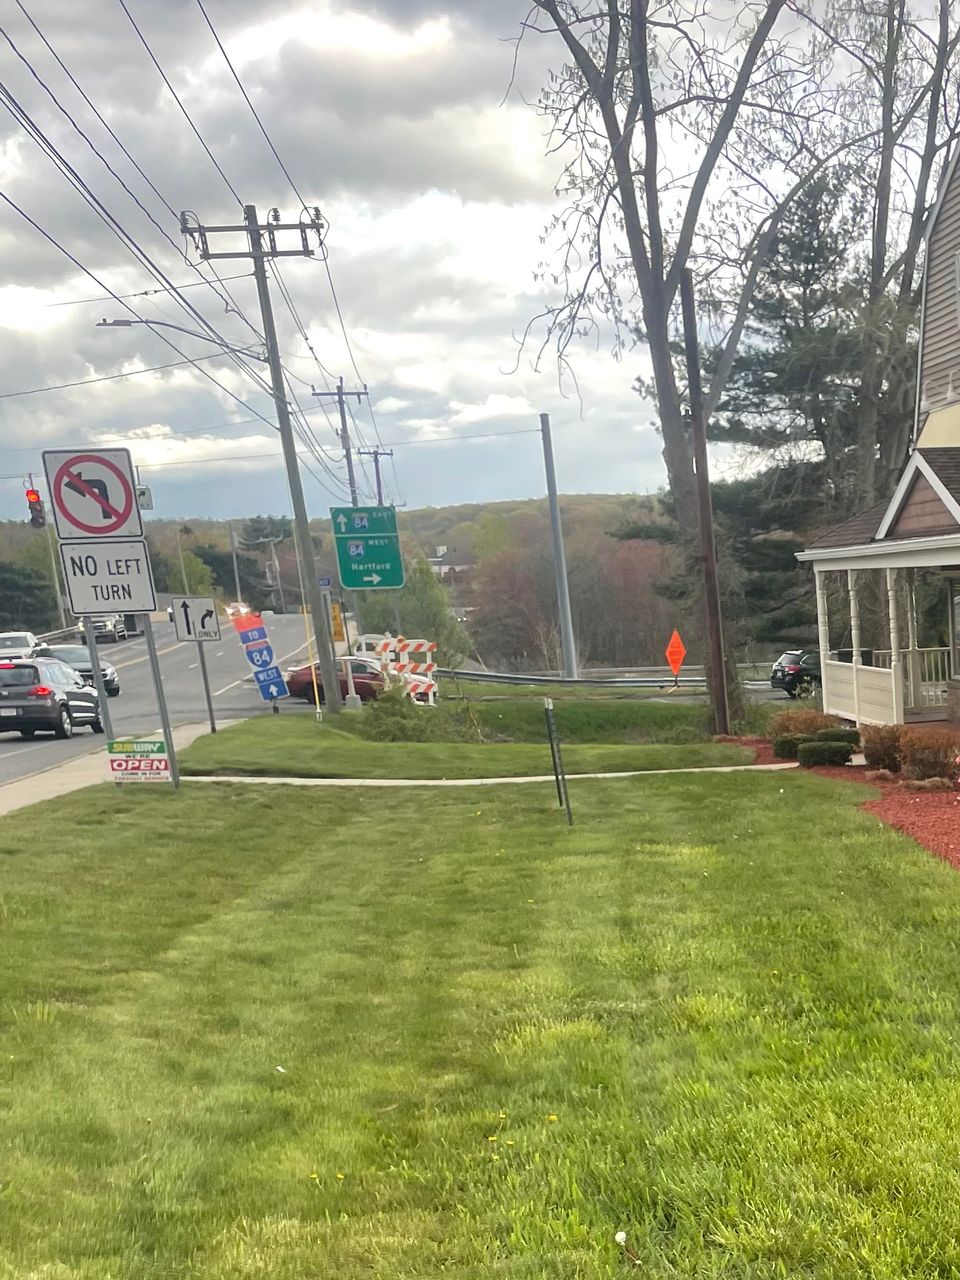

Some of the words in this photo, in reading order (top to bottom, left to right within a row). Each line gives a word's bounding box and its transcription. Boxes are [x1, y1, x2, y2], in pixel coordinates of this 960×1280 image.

[354, 516, 369, 528] 84
[349, 544, 364, 556] 84
[70, 555, 97, 577] NO
[107, 558, 141, 576] LEFT
[351, 562, 391, 571] Hartford
[91, 584, 132, 601] TURN
[198, 631, 218, 639] ONLY
[247, 630, 259, 640] TO
[252, 649, 271, 665] 84
[258, 670, 278, 681] WEST
[112, 742, 161, 752] SUBWAY
[112, 760, 166, 770] OPEN
